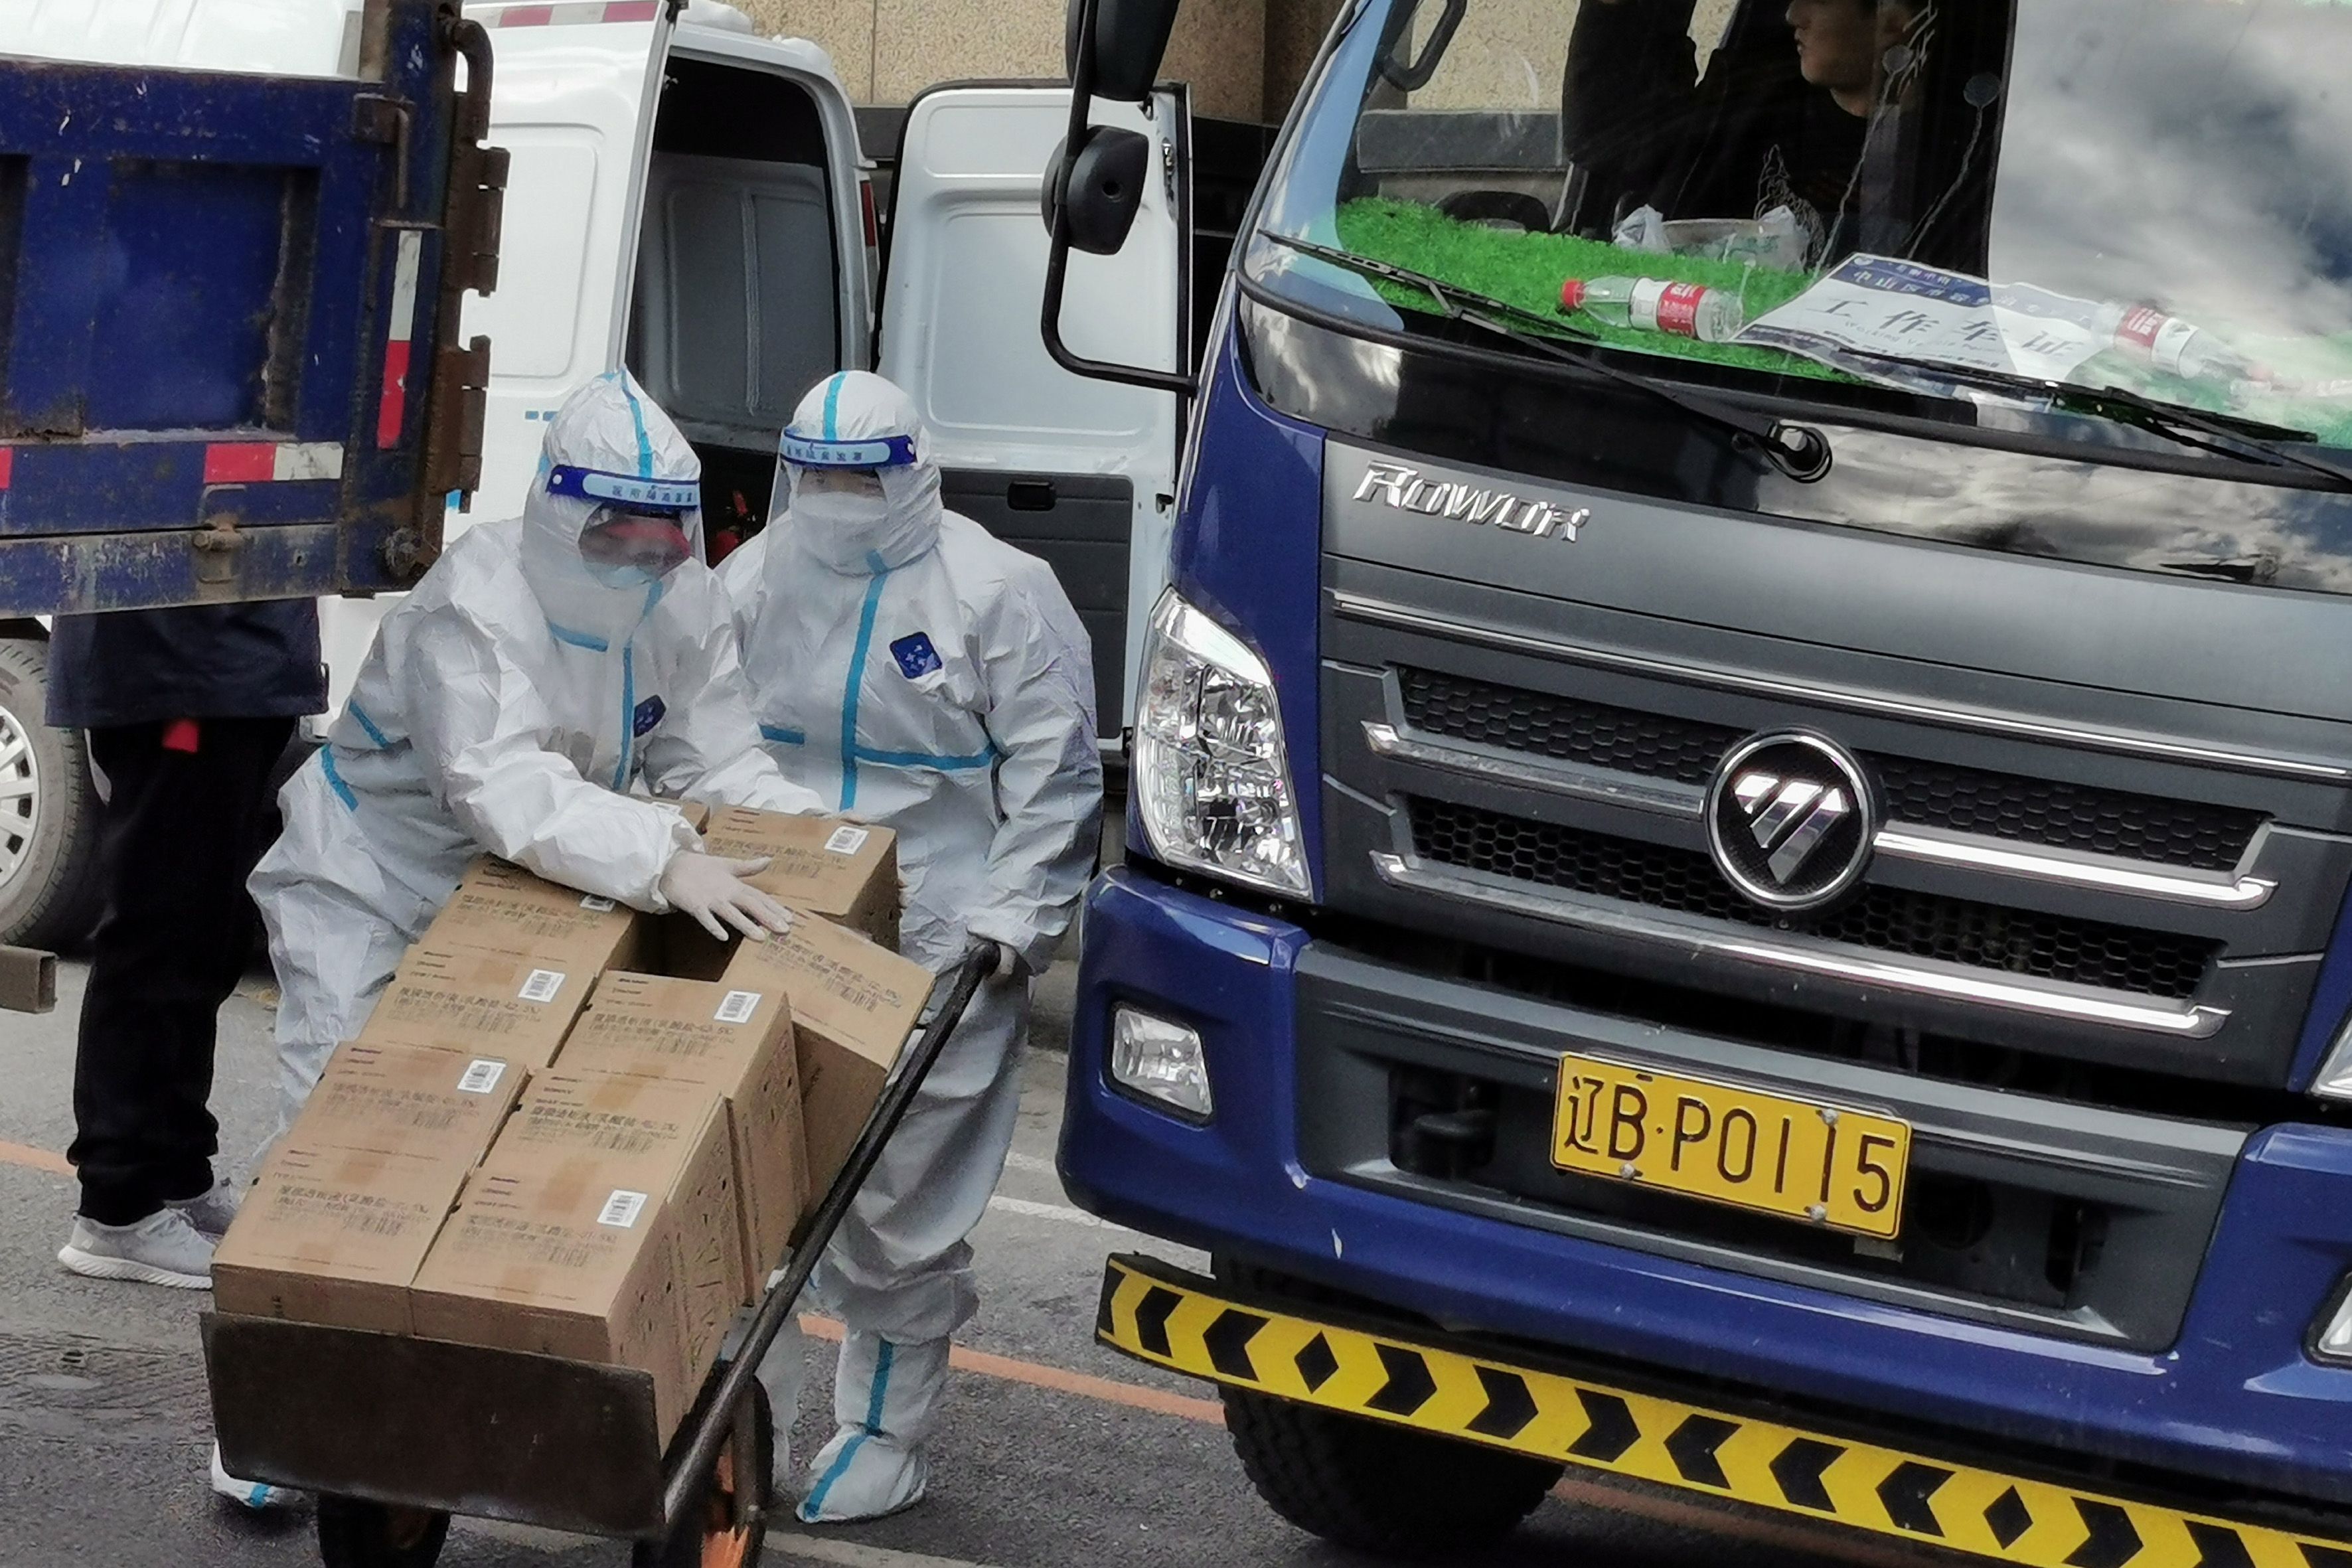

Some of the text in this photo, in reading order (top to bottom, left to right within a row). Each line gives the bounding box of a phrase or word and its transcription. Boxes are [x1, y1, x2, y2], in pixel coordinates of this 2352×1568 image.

[1806, 300, 2084, 356] 工作车证
[1564, 1074, 1897, 1213] 辽B·P0115
